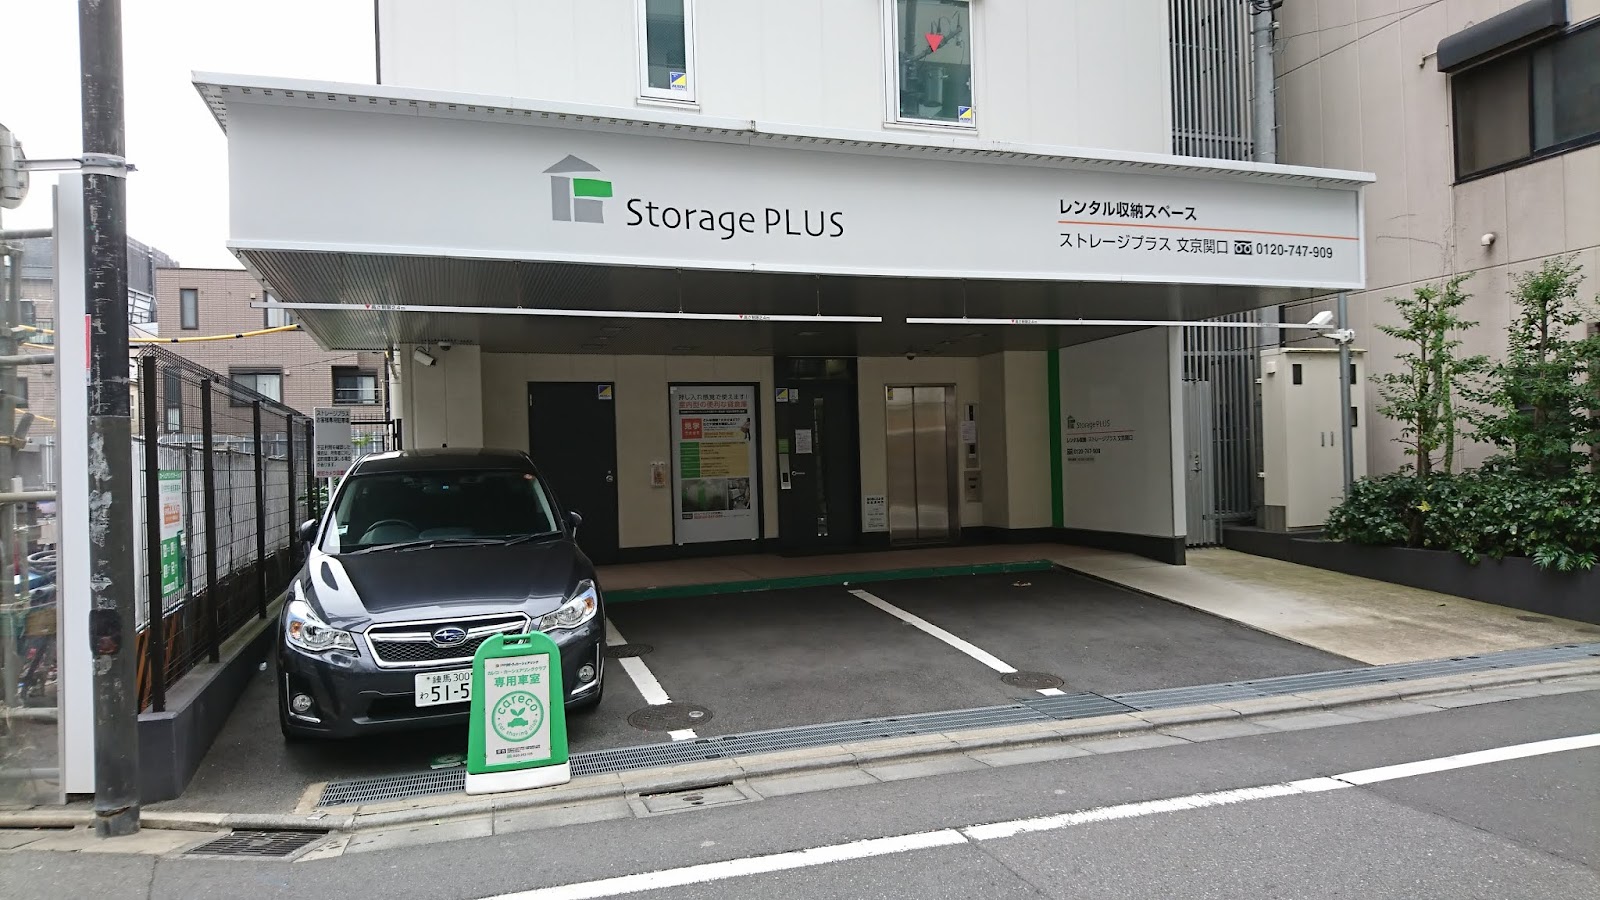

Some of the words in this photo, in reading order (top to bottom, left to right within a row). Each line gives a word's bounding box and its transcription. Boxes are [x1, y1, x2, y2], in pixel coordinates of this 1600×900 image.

[626, 198, 755, 240] Storage
[765, 207, 844, 238] PLUS
[1059, 199, 1197, 221] レンタル収納スペース
[1059, 232, 1172, 252] ストレージプラス
[1176, 236, 1229, 255] 文京関口
[1255, 242, 1333, 259] 0120-747-909
[453, 672, 470, 682] 300
[493, 673, 541, 687] 専用車室
[497, 695, 538, 716] careco
